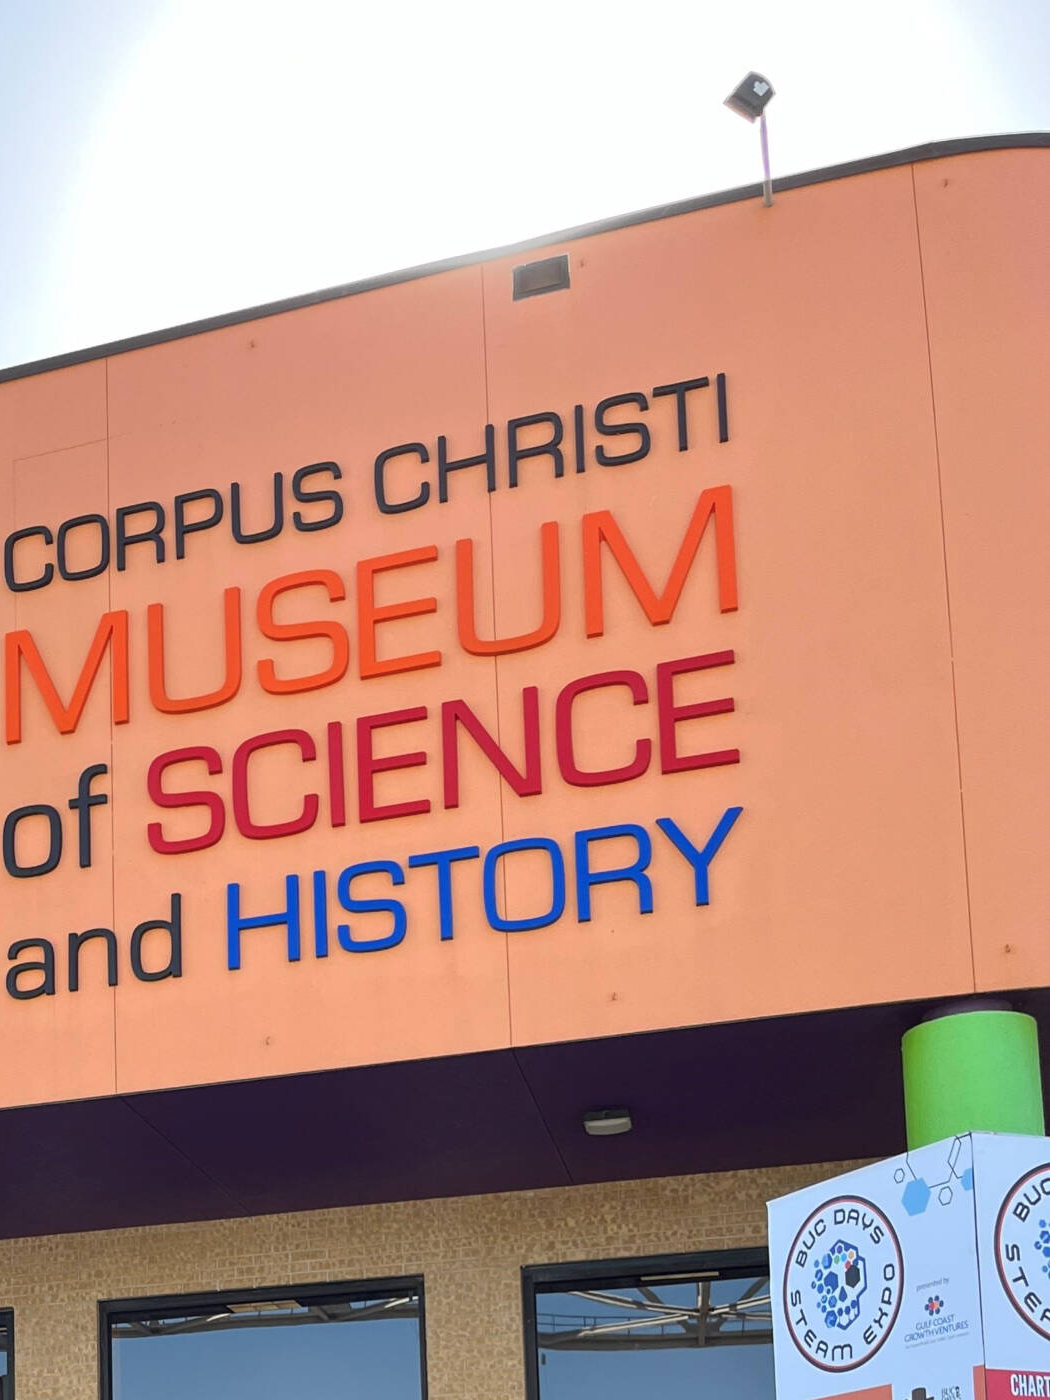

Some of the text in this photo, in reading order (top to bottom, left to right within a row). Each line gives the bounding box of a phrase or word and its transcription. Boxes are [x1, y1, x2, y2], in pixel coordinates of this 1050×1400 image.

[4, 372, 729, 592] CORPUS CHRISTI
[4, 484, 738, 746] MUSEUM
[2, 649, 741, 879] of SCIENCE
[5, 806, 744, 1001] and HISTORY
[795, 1208, 885, 1268] BUC DAYS
[790, 1263, 895, 1362] STEAM EXPO
[904, 1329, 935, 1342] GROWTH
[935, 1320, 969, 1336] VENTURES
[916, 1313, 954, 1331] GULF COAST
